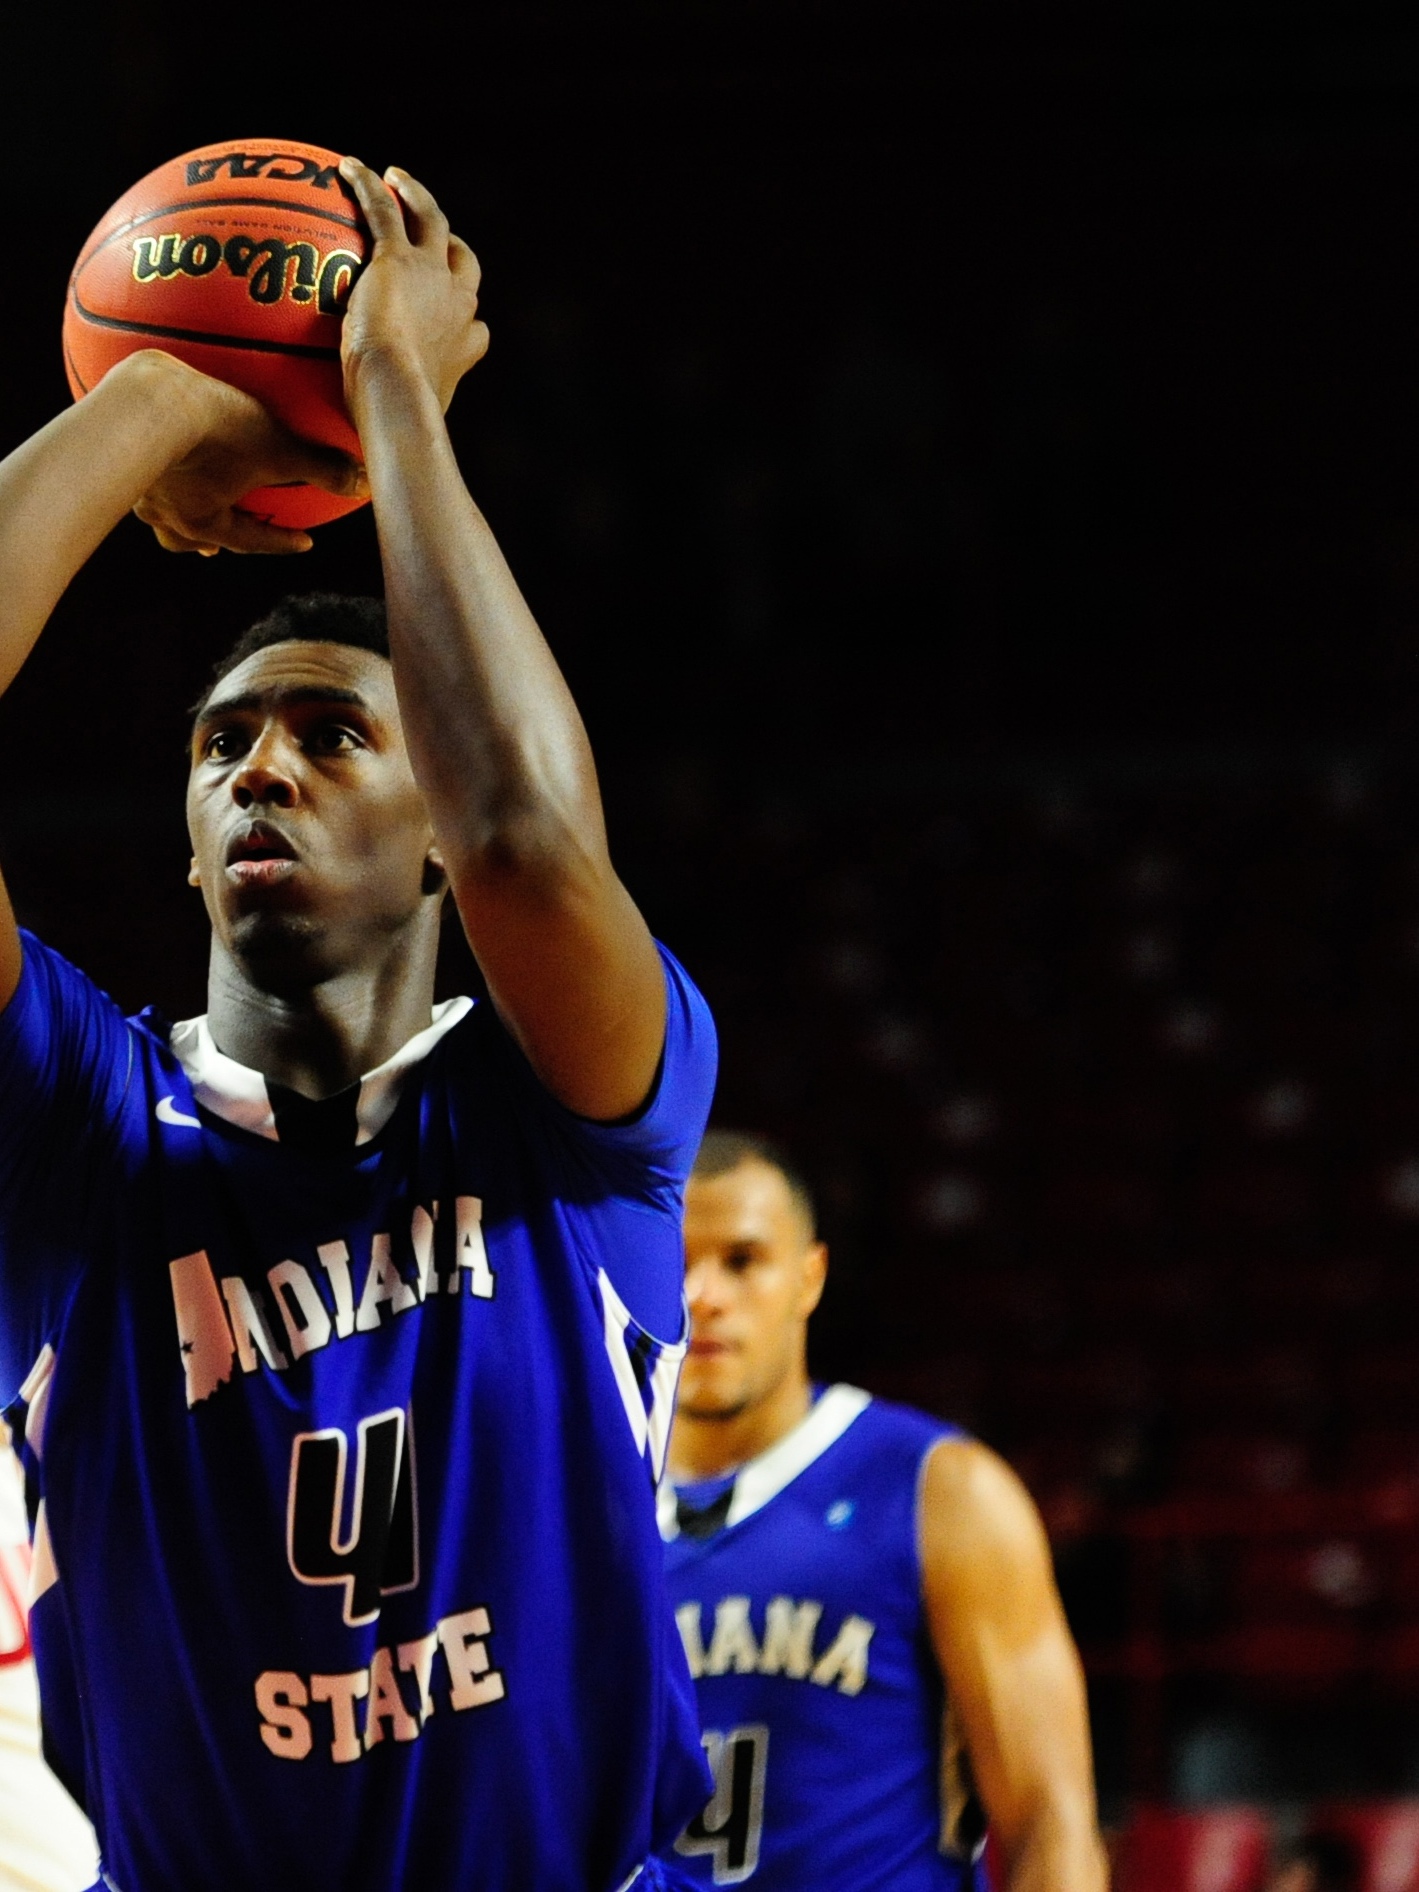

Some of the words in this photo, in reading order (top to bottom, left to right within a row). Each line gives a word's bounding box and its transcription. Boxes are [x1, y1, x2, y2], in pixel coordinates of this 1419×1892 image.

[286, 1406, 420, 1628] 4
[254, 1606, 505, 1764] STATE
[674, 1724, 770, 1886] 4
